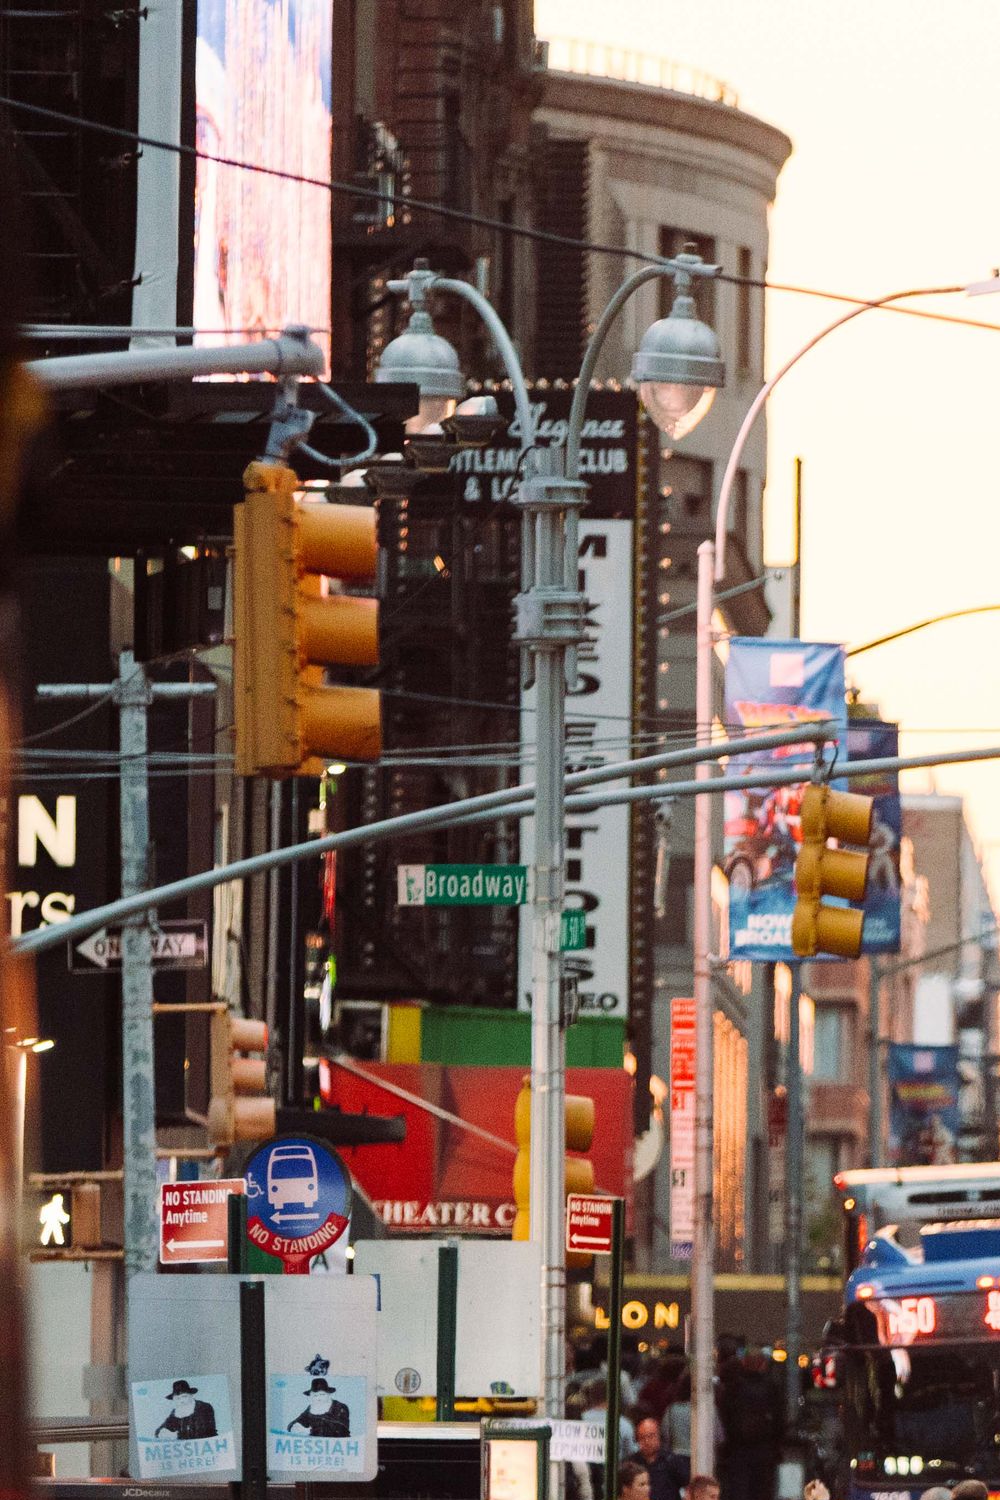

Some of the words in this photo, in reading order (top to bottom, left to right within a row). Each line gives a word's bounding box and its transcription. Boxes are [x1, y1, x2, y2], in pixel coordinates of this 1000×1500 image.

[507, 402, 625, 447] Elegnce
[426, 870, 525, 905] Broadway
[94, 933, 121, 955] ON
[166, 1191, 180, 1206] NO
[571, 1200, 581, 1212] NO
[582, 1201, 612, 1214] STANDIN
[166, 1209, 208, 1228] Anytime
[570, 1213, 600, 1227] Anytime
[249, 1224, 269, 1244] NO
[272, 1221, 339, 1254] STANDING
[585, 1424, 605, 1439] ZON
[145, 1439, 228, 1462] MESSIAH
[275, 1438, 359, 1457] MESSIAH
[570, 1442, 603, 1458] MOVIN
[160, 1461, 174, 1471] IS
[178, 1455, 217, 1469] HERE!
[290, 1456, 302, 1465] IS
[307, 1456, 345, 1467] HERE!
[122, 1488, 171, 1498] JCDecaux
